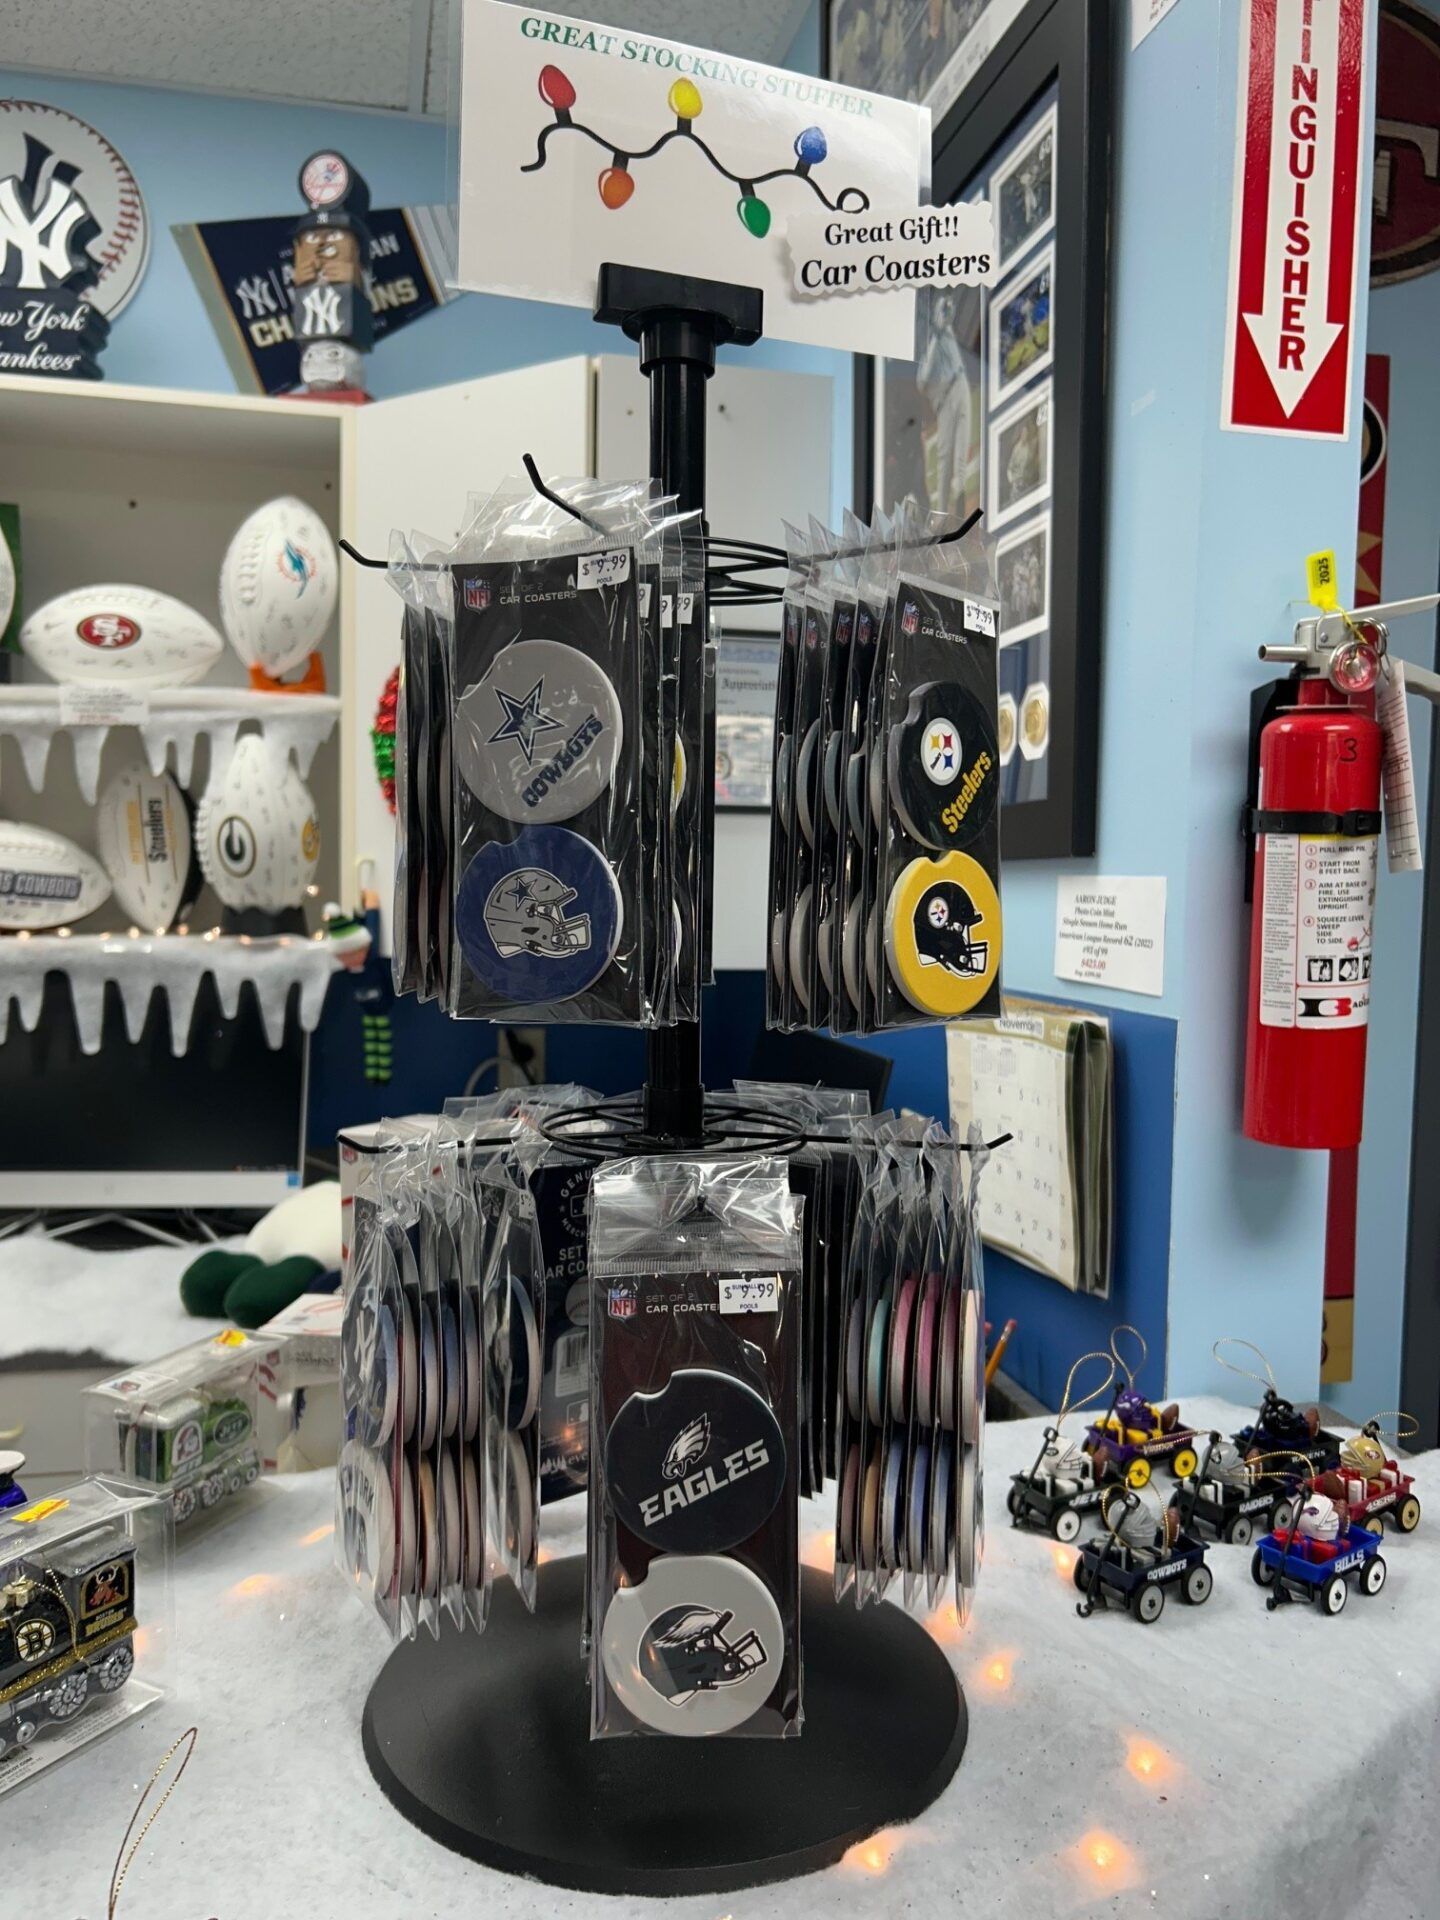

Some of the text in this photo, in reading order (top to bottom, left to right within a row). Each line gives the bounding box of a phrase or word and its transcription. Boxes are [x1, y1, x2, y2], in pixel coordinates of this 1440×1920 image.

[520, 17, 875, 120] GREAT STOCKING STUFFER
[823, 216, 959, 246] Great Gift!!
[800, 251, 992, 289] Car Coasters
[24, 300, 90, 342] York
[0, 341, 75, 371] ankees
[597, 554, 627, 574] 9.99
[1320, 557, 1330, 585] 2025
[500, 590, 577, 605] CAR COASTERS
[921, 626, 968, 645] CAR COASTERS
[721, 677, 776, 691] Appreciati
[1339, 737, 1357, 763] 3
[521, 713, 604, 808] COWBOYS
[940, 751, 992, 834] Steelers
[1075, 894, 1117, 906] AARON JUDGE
[1318, 895, 1364, 903] EXTINGUISHER
[1316, 915, 1347, 923] SQUEEZE
[559, 1245, 584, 1261] SET
[545, 1264, 564, 1280] AR
[645, 1293, 694, 1303] SET OF 2
[741, 1283, 774, 1299] 9.99
[611, 1300, 638, 1317] NFL
[646, 1303, 719, 1314] CAR COASTE
[637, 1438, 770, 1527] EAGLES
[1238, 1493, 1274, 1513] RAIDERS
[1365, 1492, 1397, 1513] 49ERS
[1147, 1558, 1188, 1580] COWBOYS
[1334, 1549, 1365, 1573] BILLS
